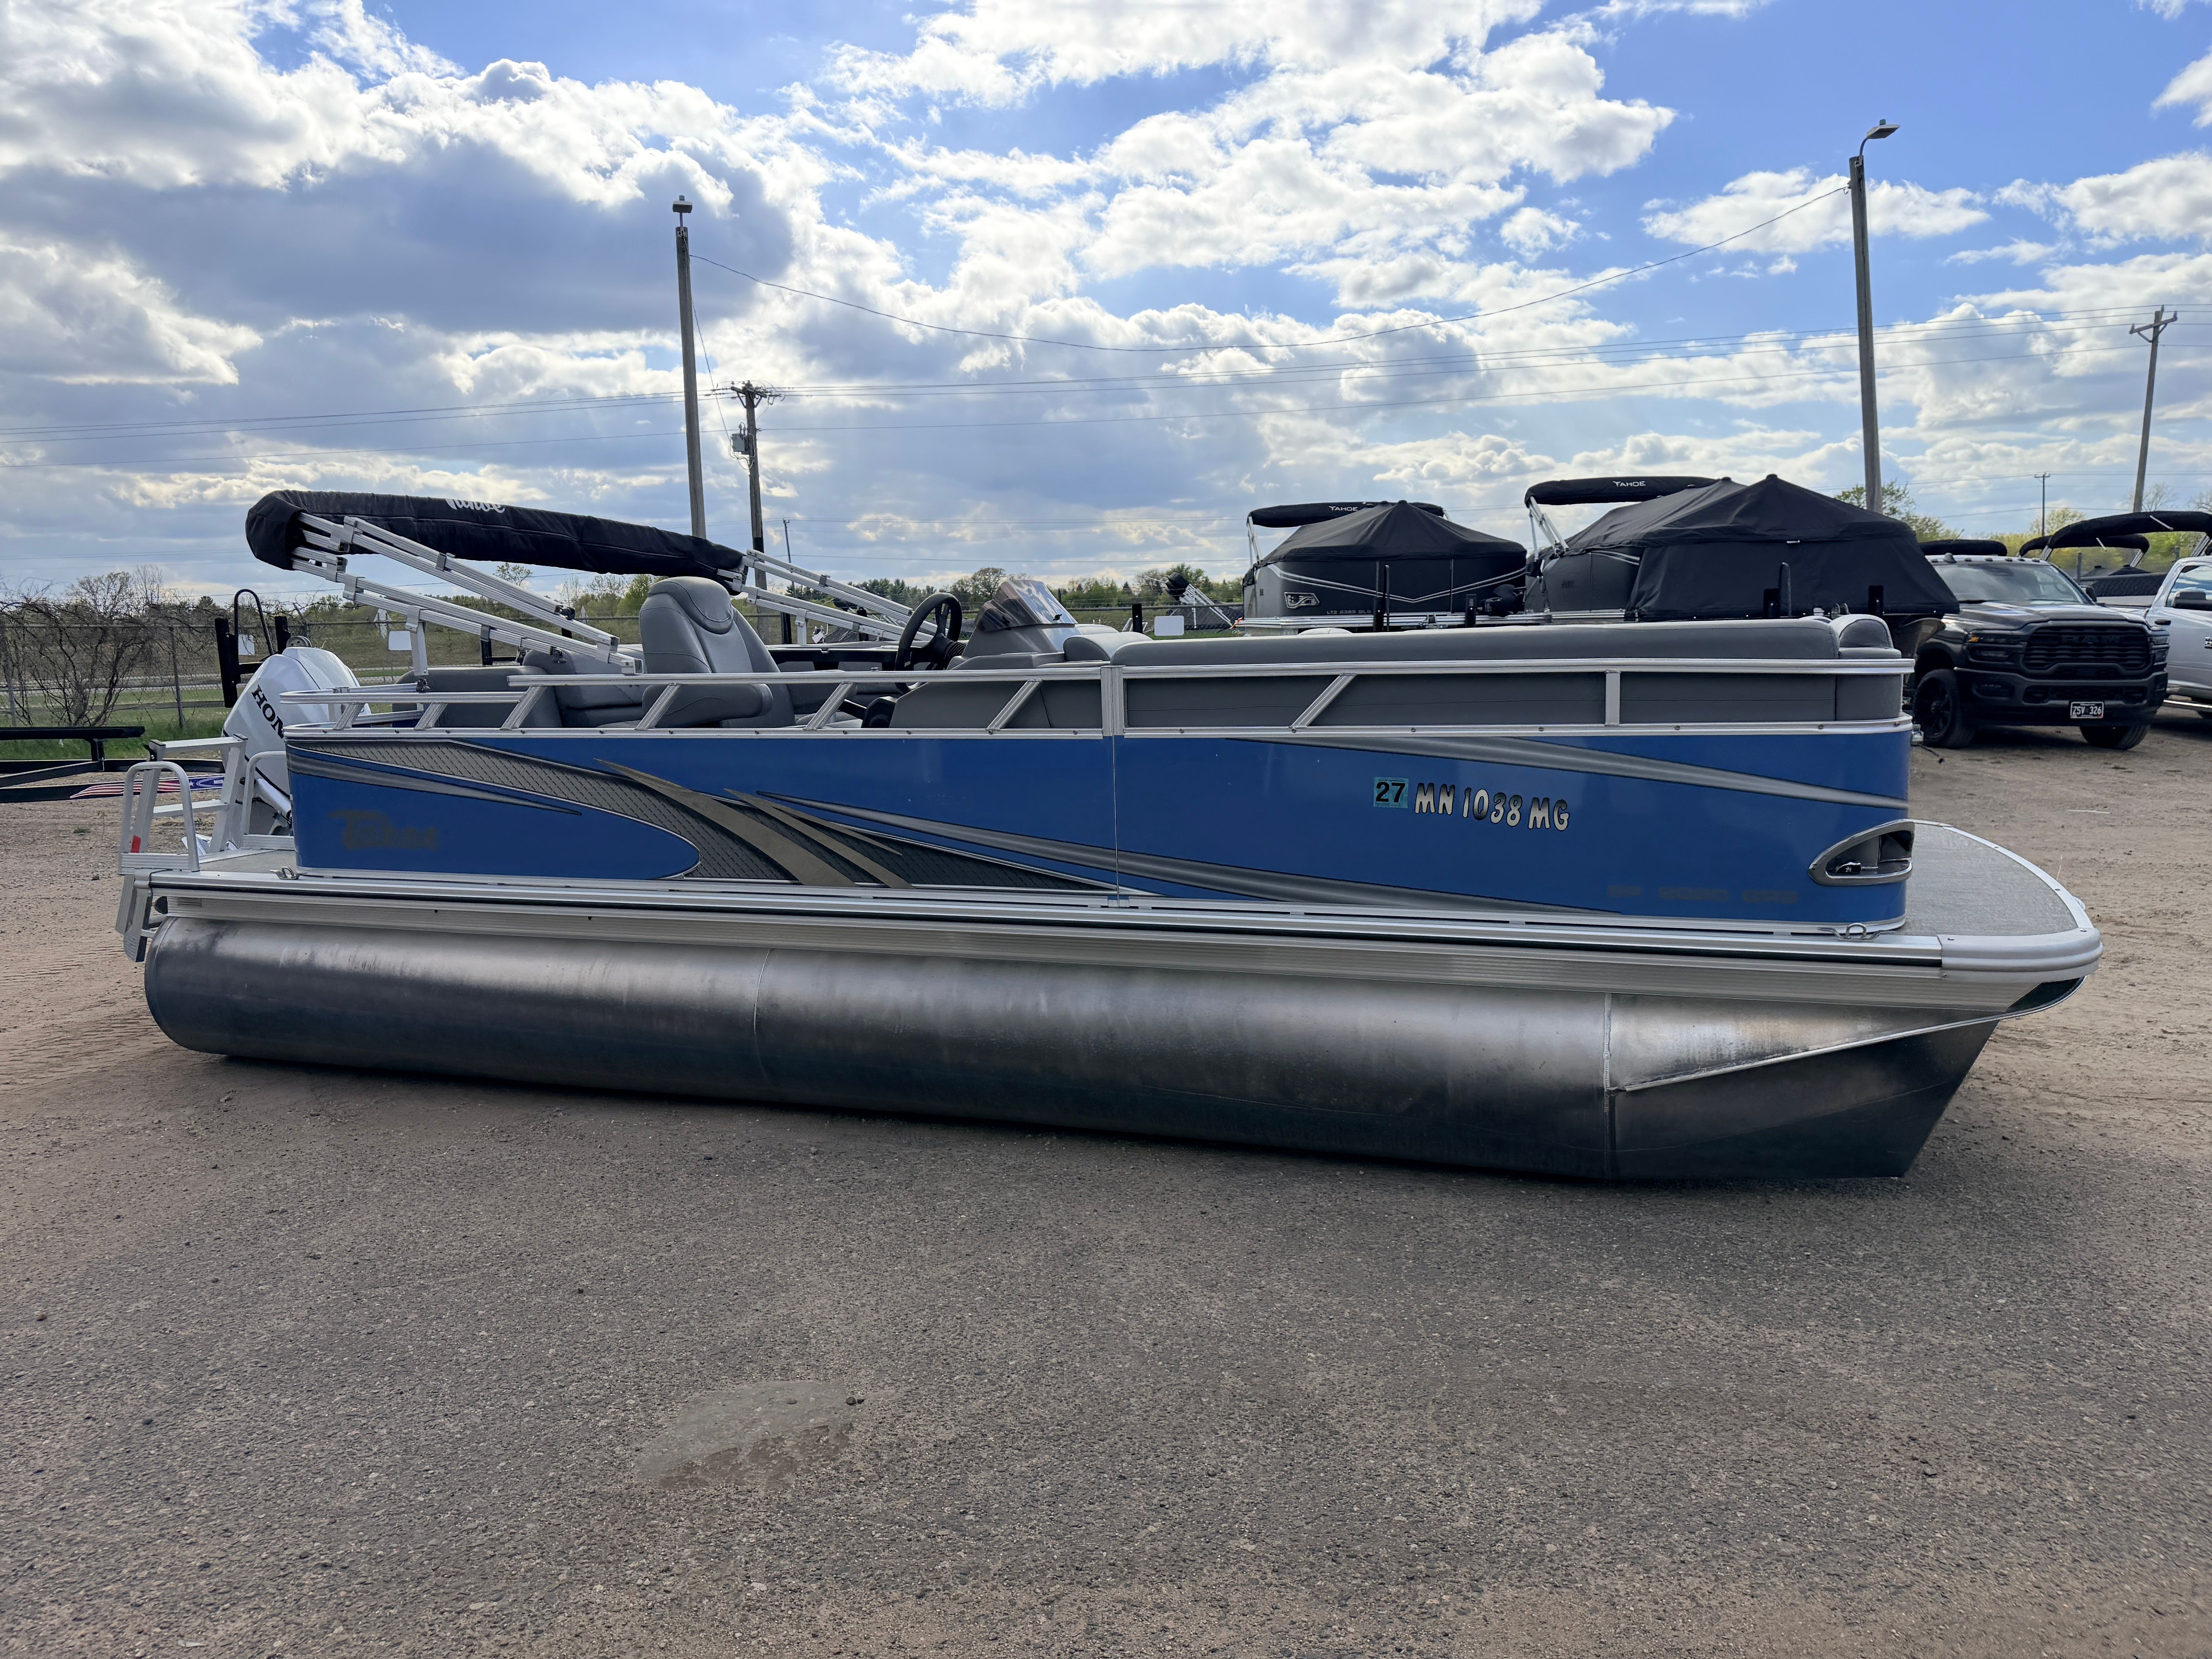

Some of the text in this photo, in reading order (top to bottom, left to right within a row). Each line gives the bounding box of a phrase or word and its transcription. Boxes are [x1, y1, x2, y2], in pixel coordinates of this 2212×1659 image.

[2061, 635, 2120, 644] RAM
[251, 684, 284, 739] HON
[2089, 706, 2101, 715] 326
[1376, 781, 1405, 803] 27
[1415, 782, 1570, 831] MN 1038 MG
